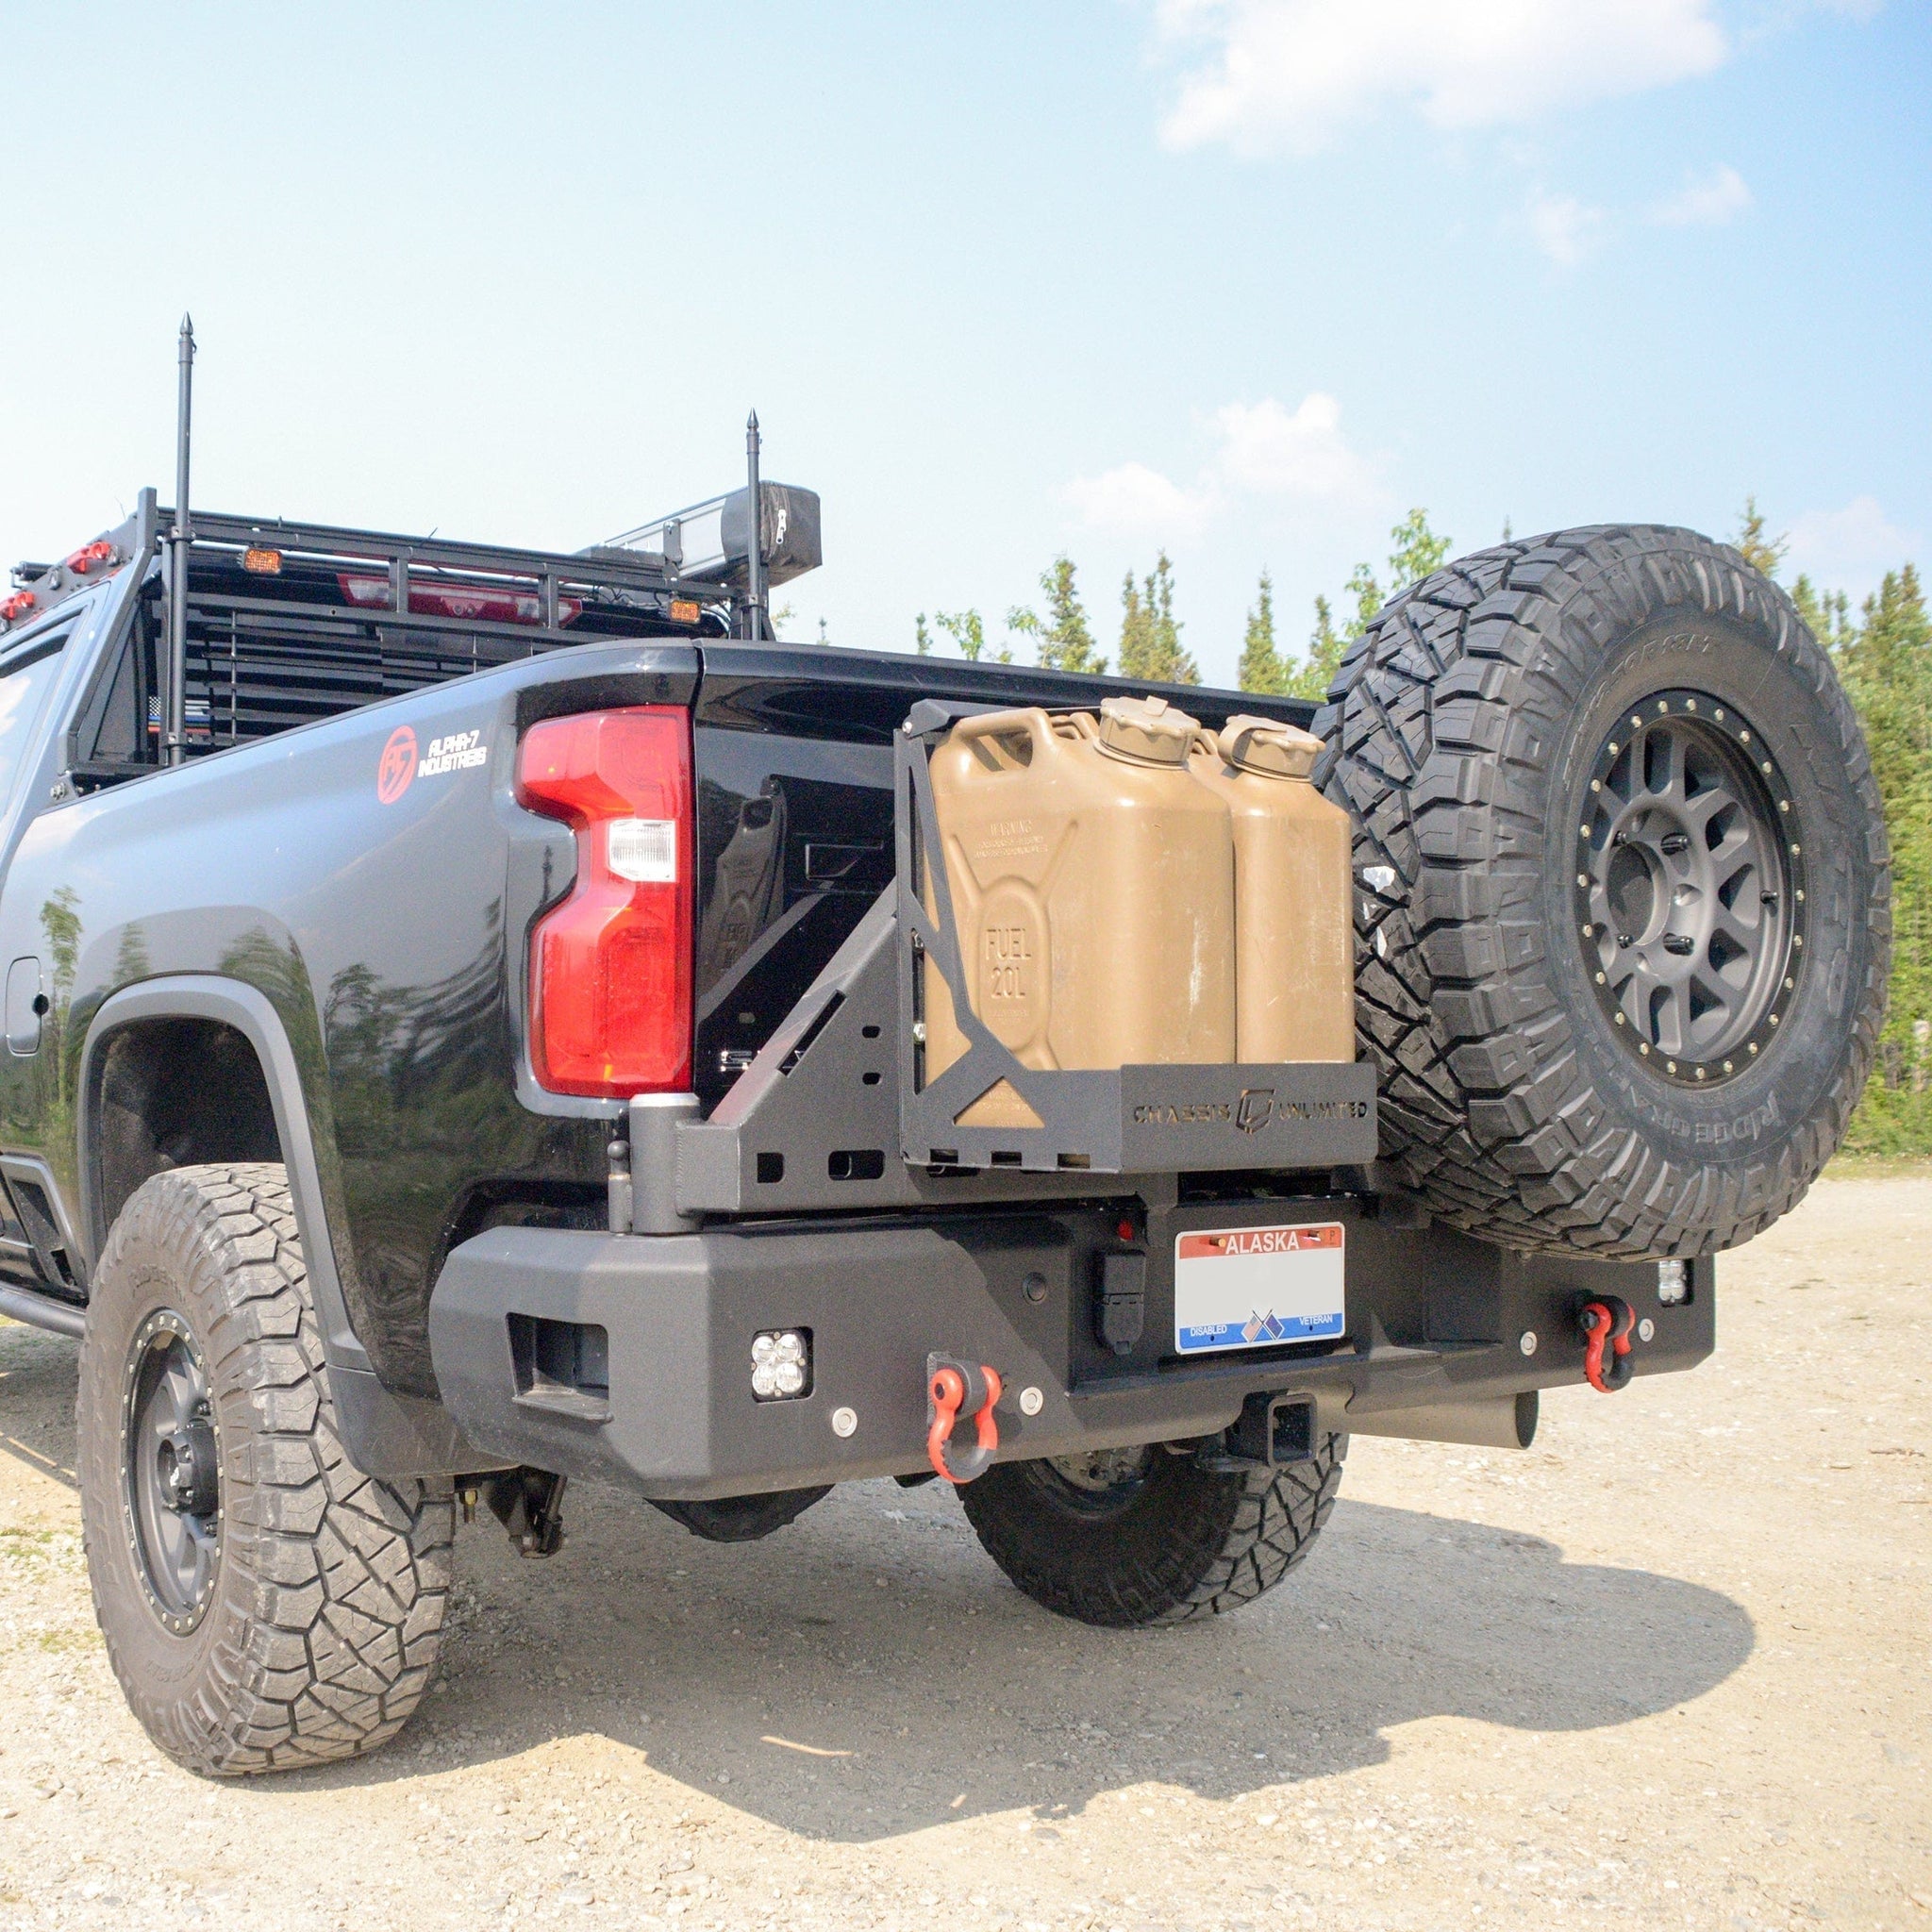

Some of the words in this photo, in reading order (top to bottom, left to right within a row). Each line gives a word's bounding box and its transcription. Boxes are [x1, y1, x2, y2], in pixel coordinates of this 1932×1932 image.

[427, 729, 480, 758] ALPHA-7
[986, 928, 1032, 961] FUEL
[991, 967, 1026, 999] 20L
[1133, 1103, 1231, 1124] CHASSIS
[1278, 1100, 1368, 1122] UNLIMITED
[1225, 1230, 1300, 1256] ALASKA
[1190, 1324, 1228, 1338] DISABLED
[1299, 1313, 1334, 1326] VETERAN
